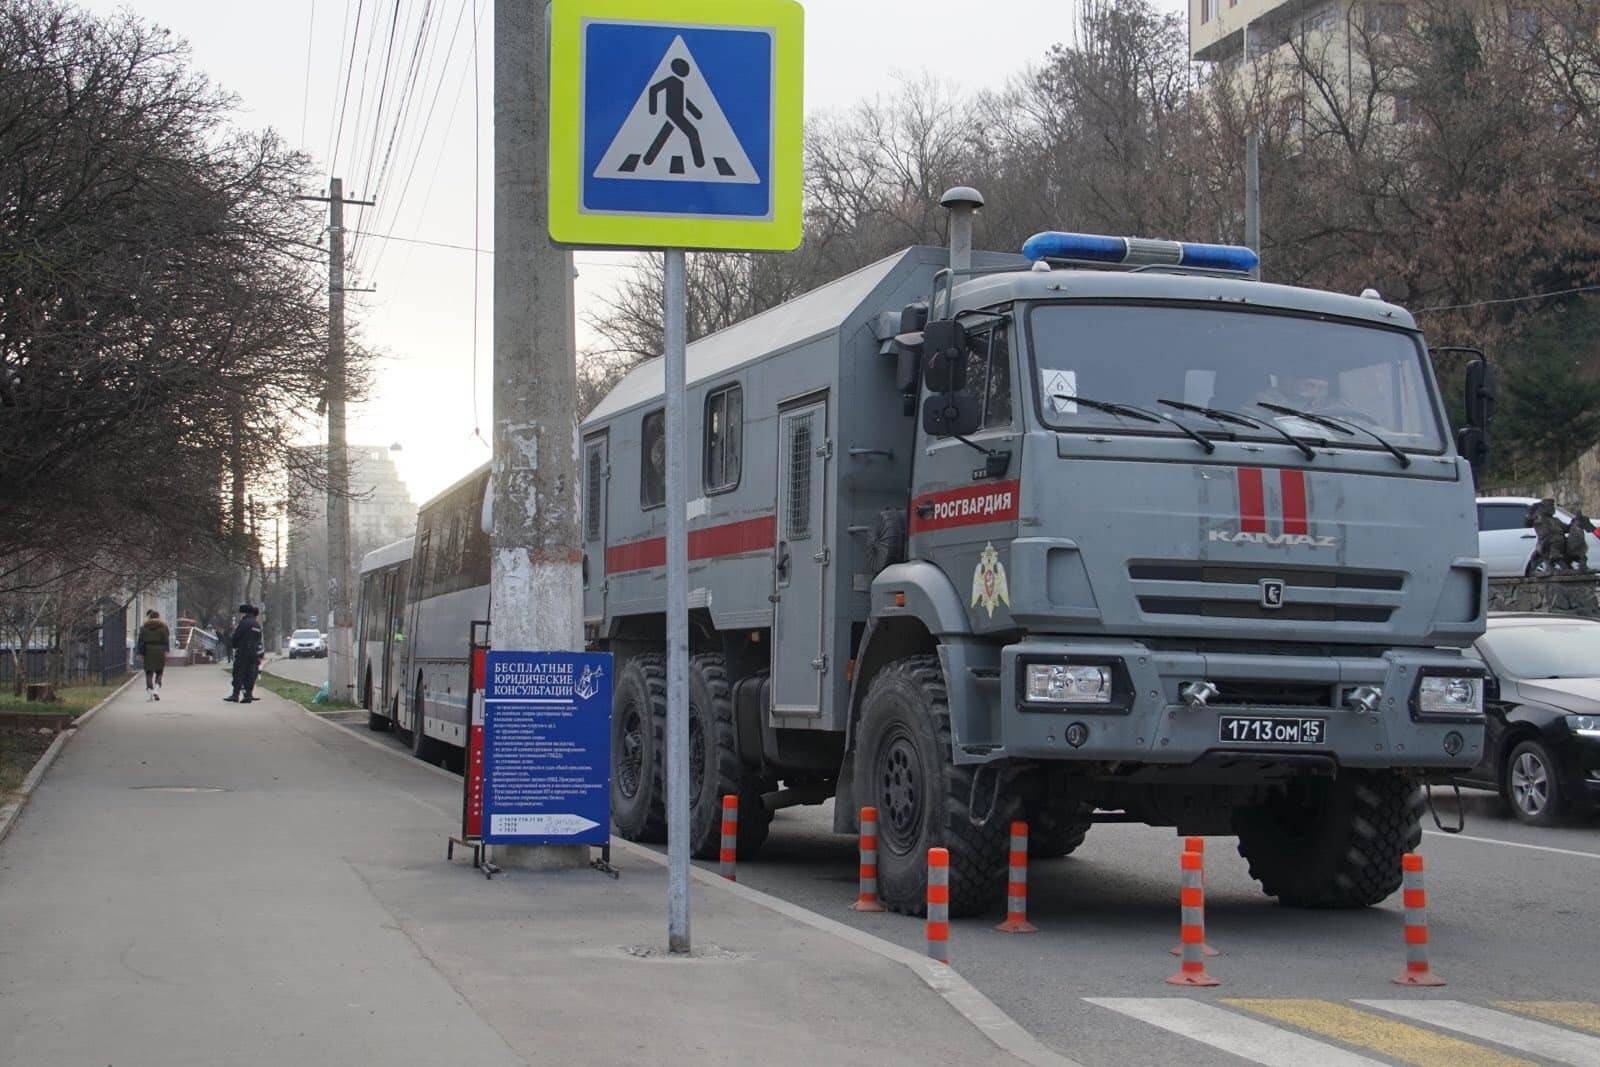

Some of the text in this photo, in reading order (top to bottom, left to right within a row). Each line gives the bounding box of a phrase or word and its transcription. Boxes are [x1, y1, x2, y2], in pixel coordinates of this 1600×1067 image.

[1056, 380, 1064, 392] 6
[934, 492, 1011, 519] РОСГВАРДИЯ
[1208, 530, 1337, 546] KAMAZ
[494, 663, 574, 673] БЕСПЛАТНЫЕ
[494, 674, 574, 686] ЮРИДИЧЕСКИЕ
[494, 685, 574, 696] КОНСУЛЬТАЦИИ
[1302, 721, 1320, 736] 15
